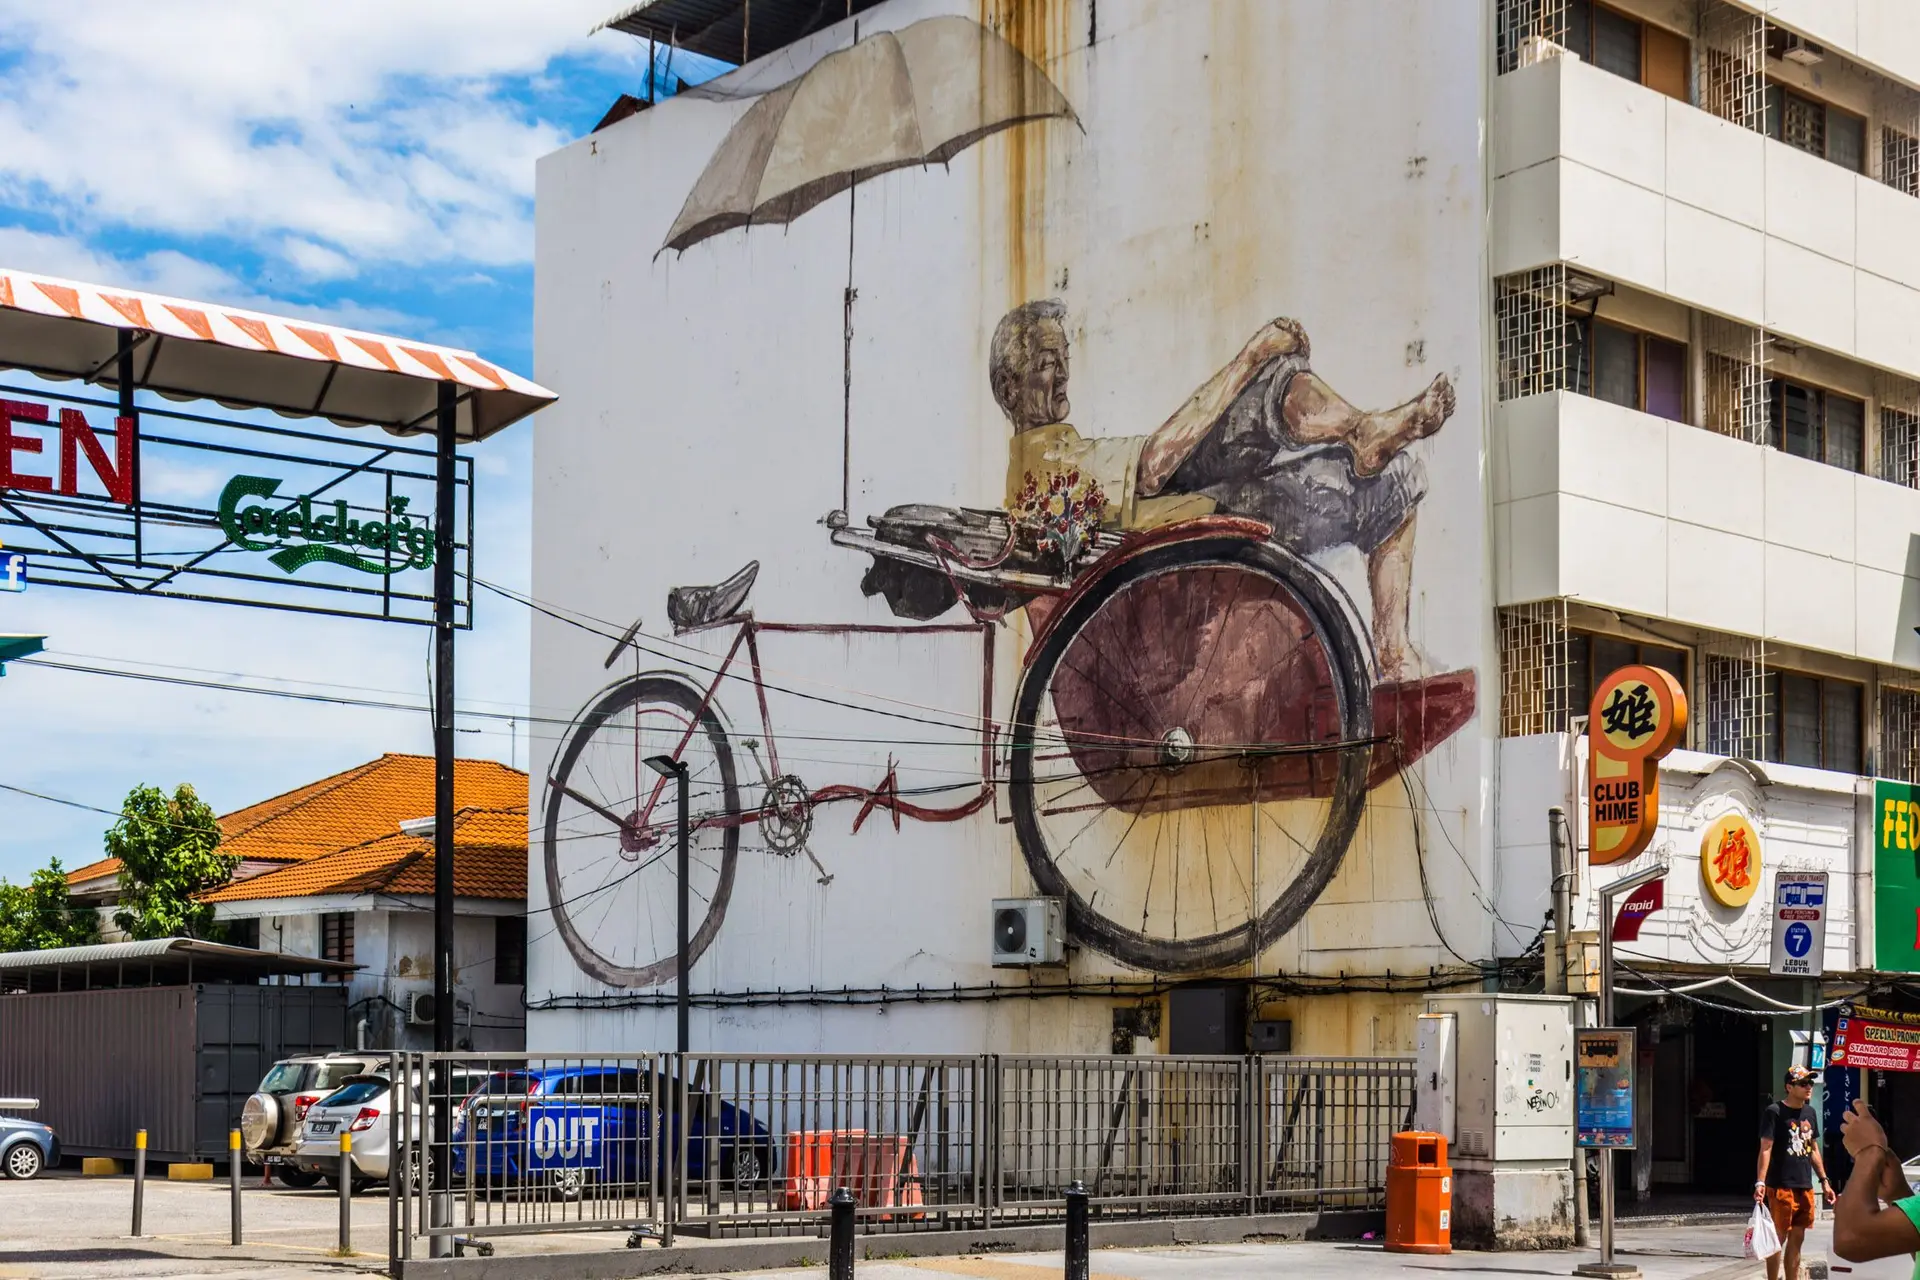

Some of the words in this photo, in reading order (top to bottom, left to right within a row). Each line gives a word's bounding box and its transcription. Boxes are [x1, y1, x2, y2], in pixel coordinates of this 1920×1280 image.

[0, 399, 133, 505] EN
[218, 474, 436, 571] Carlsberg
[1594, 781, 1640, 802] CLUB
[1595, 801, 1639, 822] HIME
[1883, 799, 1920, 851] FED
[1624, 899, 1654, 913] rapid
[1793, 935, 1804, 952] 7
[1782, 966, 1810, 974] MUNTRI
[1784, 959, 1808, 967] LEBUH
[1864, 1027, 1895, 1042] SPECIAL
[1896, 1030, 1920, 1044] PROMO
[1849, 1043, 1888, 1055] STANDARD
[1888, 1047, 1909, 1057] ROOM
[1848, 1055, 1868, 1066] TWIN
[1868, 1057, 1896, 1068] DOUBLE
[534, 1116, 599, 1160] OUT
